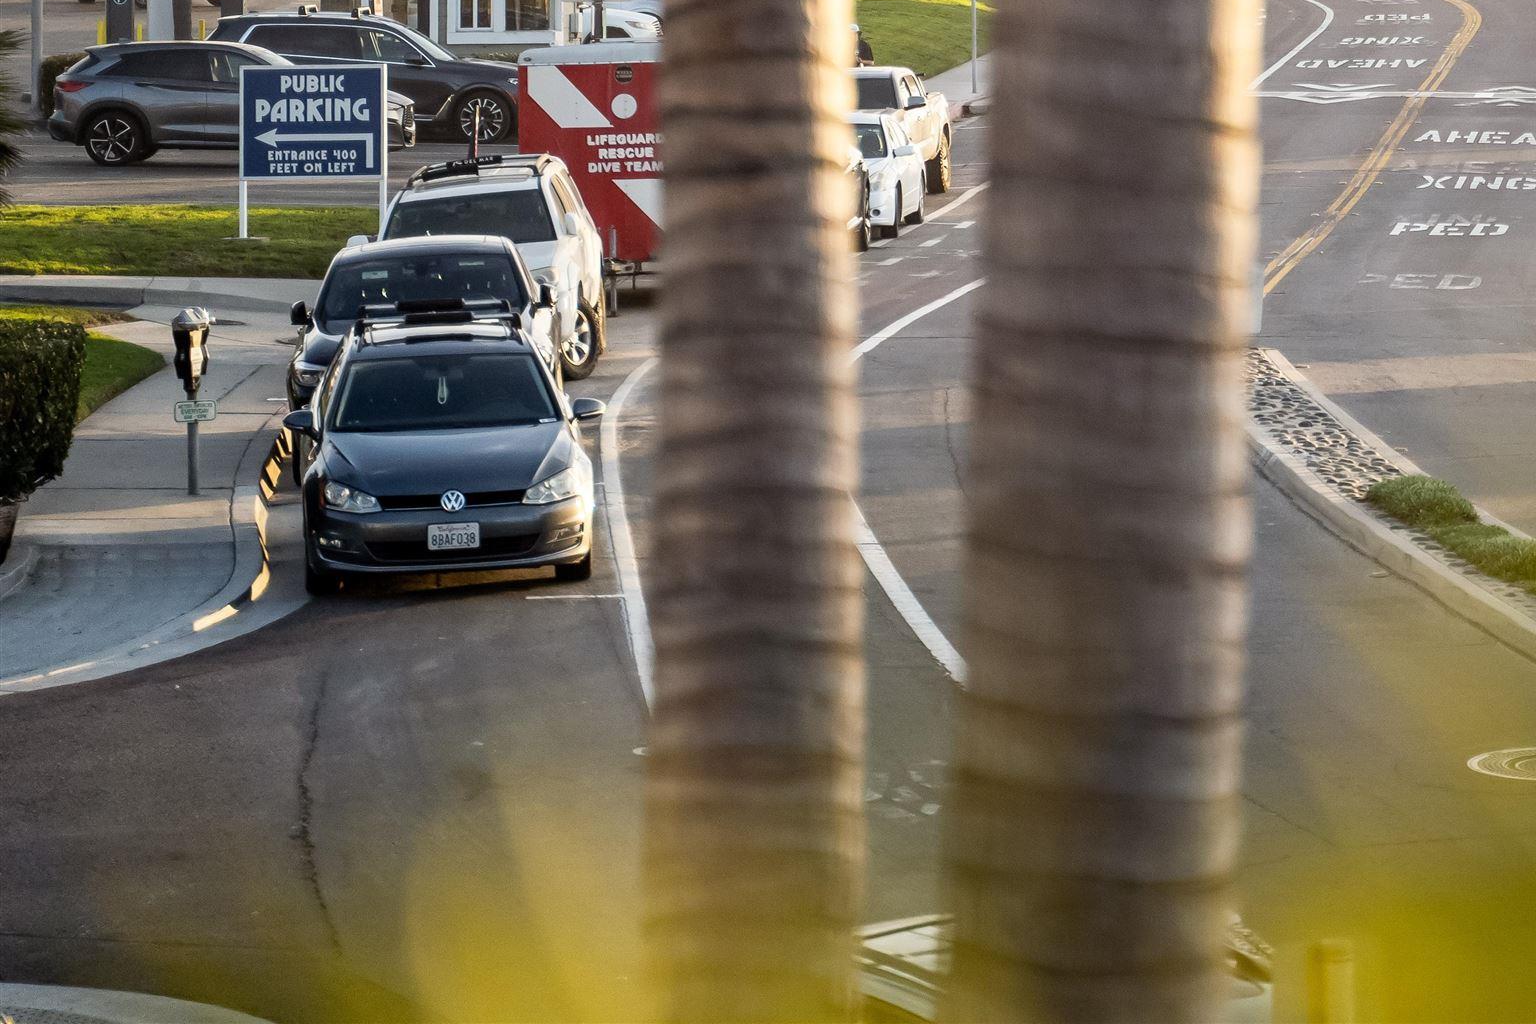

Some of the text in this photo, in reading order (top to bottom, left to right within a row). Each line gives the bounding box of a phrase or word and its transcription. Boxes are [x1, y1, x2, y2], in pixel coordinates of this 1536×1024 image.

[280, 75, 344, 93] PUBLIC
[255, 98, 370, 122] PARKING
[267, 150, 357, 161] ENTRANCE 400
[598, 147, 654, 159] RESCUE
[270, 162, 355, 174] FEET ON LEFT
[588, 162, 621, 173] DIVE
[1389, 222, 1509, 236] PED
[431, 532, 476, 546] 8BAF038
